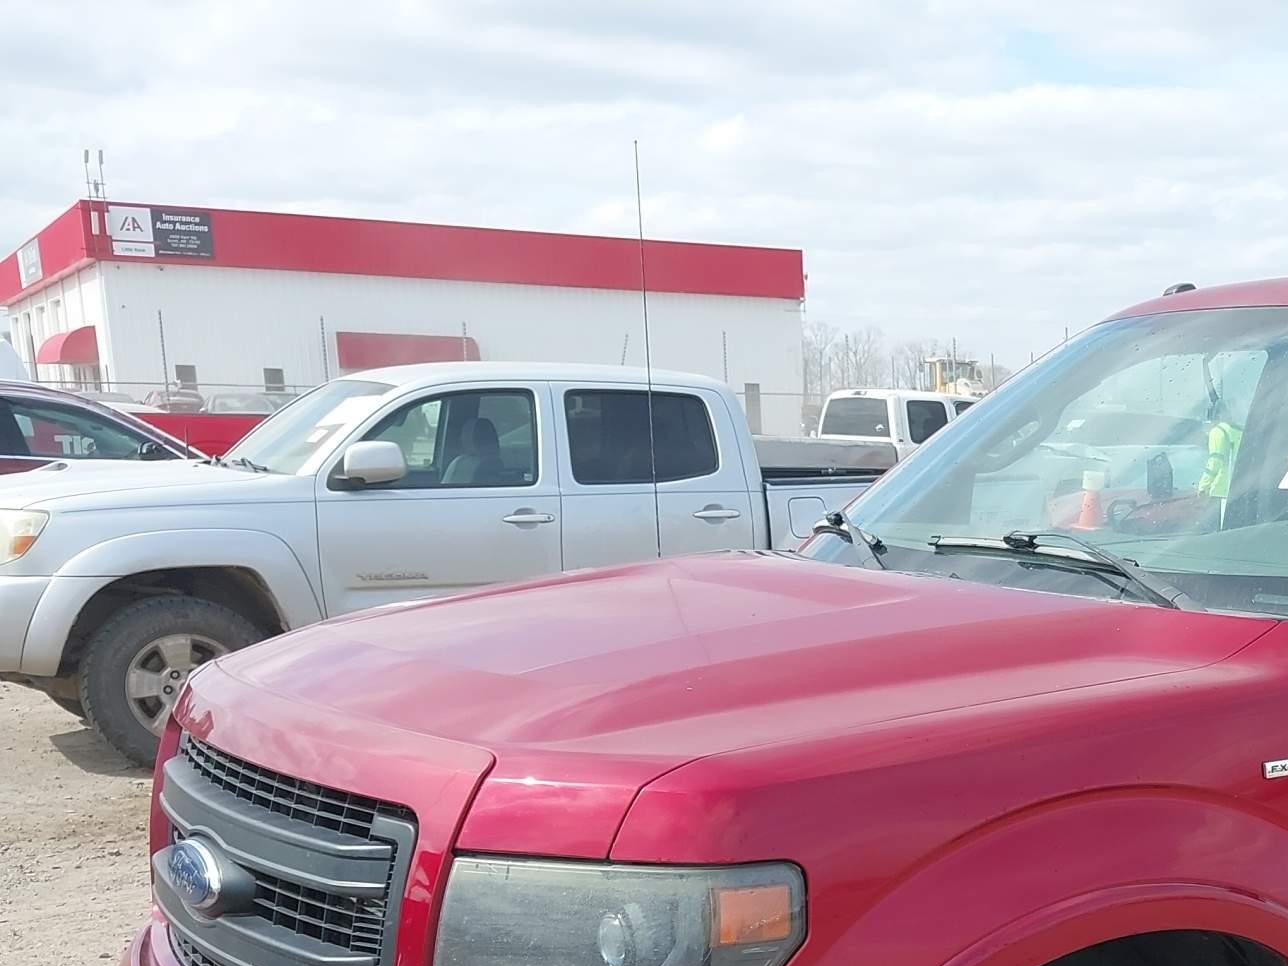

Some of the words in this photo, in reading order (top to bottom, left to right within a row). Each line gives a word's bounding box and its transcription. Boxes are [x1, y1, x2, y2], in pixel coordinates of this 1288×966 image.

[161, 213, 200, 223] Insurance
[155, 221, 174, 230] Auto
[175, 222, 209, 232] Auctions
